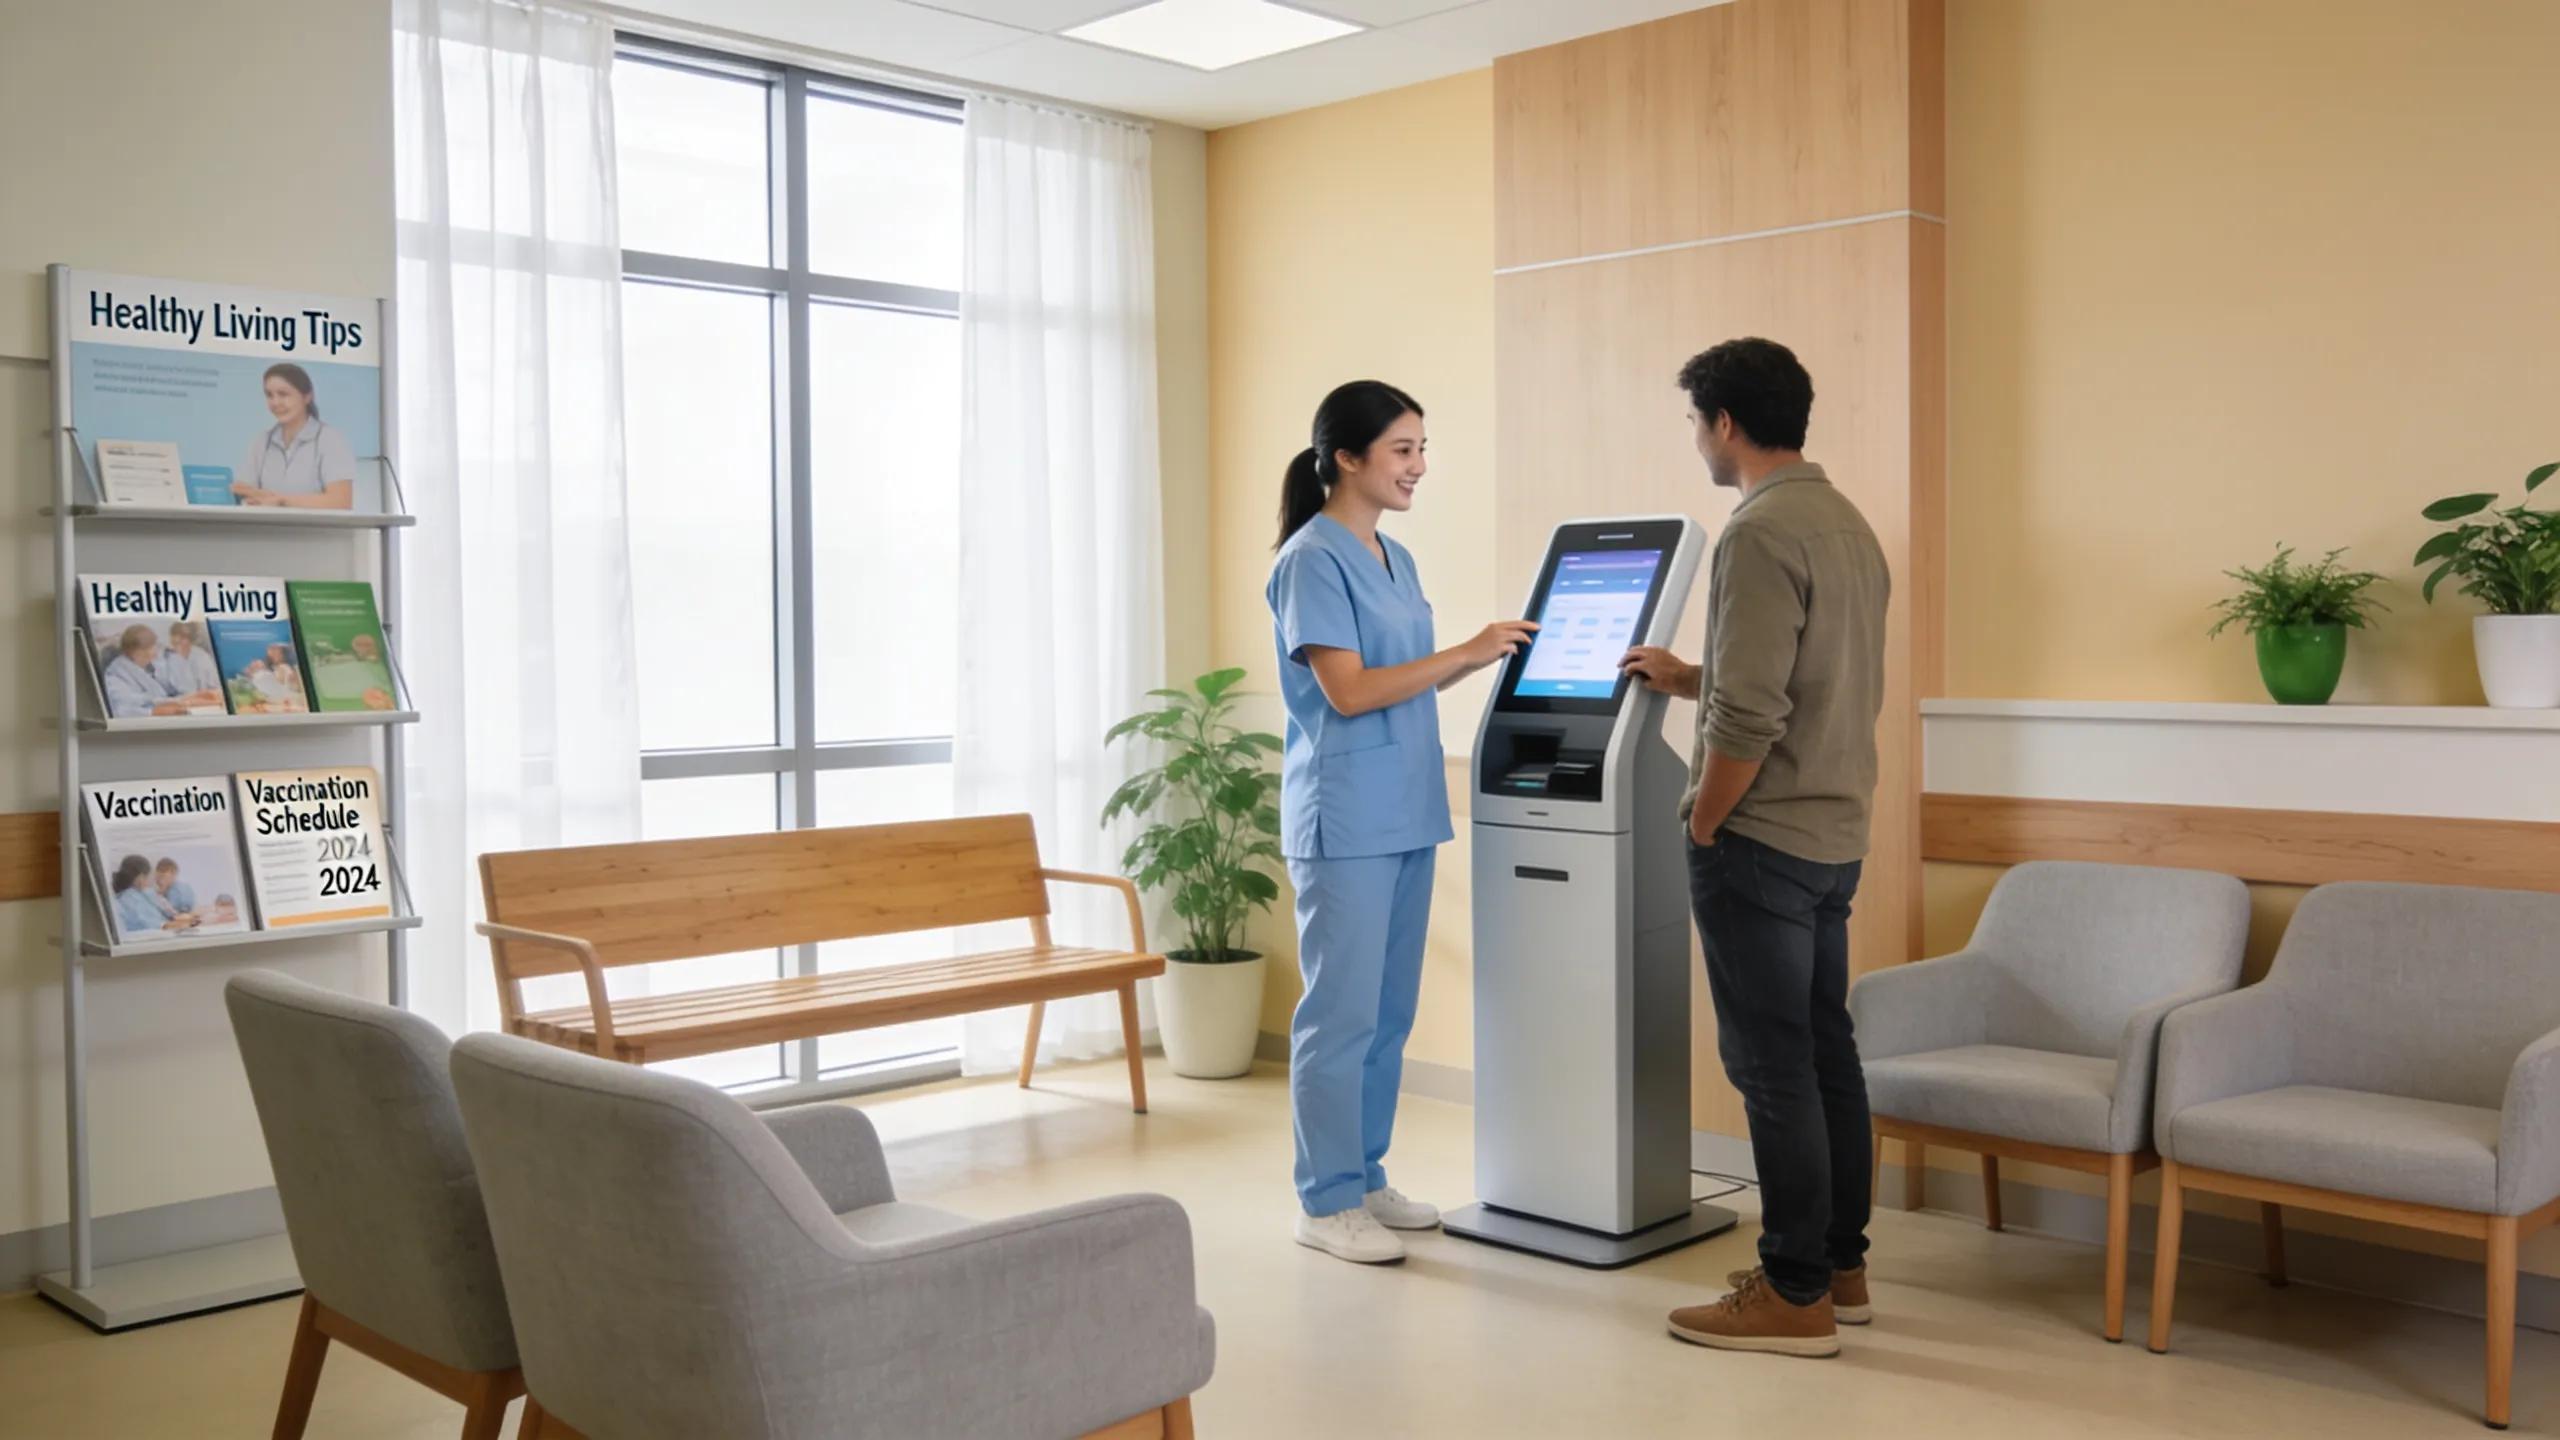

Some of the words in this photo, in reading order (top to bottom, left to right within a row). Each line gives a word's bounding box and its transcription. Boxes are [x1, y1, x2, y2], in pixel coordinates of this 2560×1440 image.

[90, 290, 204, 344] Healthy
[213, 303, 296, 351] Living
[302, 310, 362, 355] Tips
[91, 580, 192, 620] Healthy
[201, 582, 278, 620] Living
[94, 786, 226, 820] Vaccination
[246, 775, 369, 804] Vaccination
[256, 802, 360, 835] Schedule
[319, 863, 381, 896] 2024
